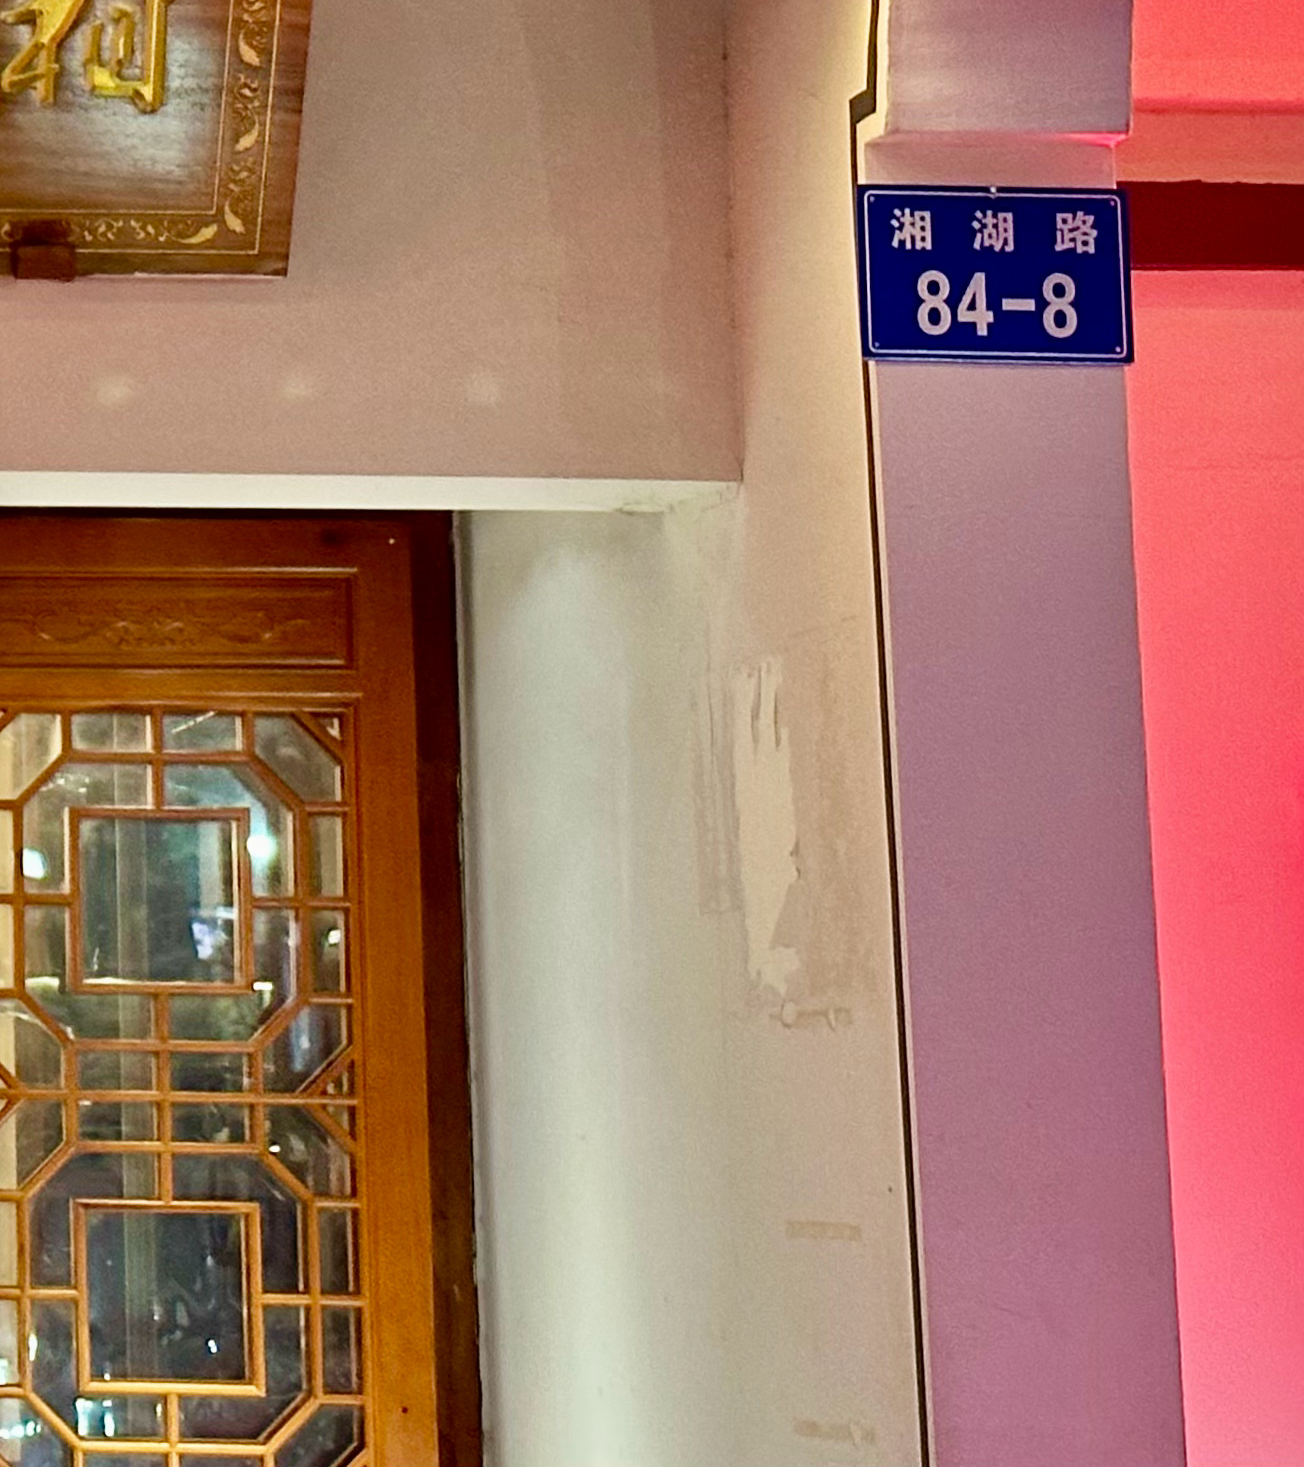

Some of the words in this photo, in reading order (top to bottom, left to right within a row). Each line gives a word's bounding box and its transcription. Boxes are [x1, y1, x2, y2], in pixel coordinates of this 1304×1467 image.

[890, 207, 1098, 254] 湘湖路
[916, 270, 1078, 338] 84-8
